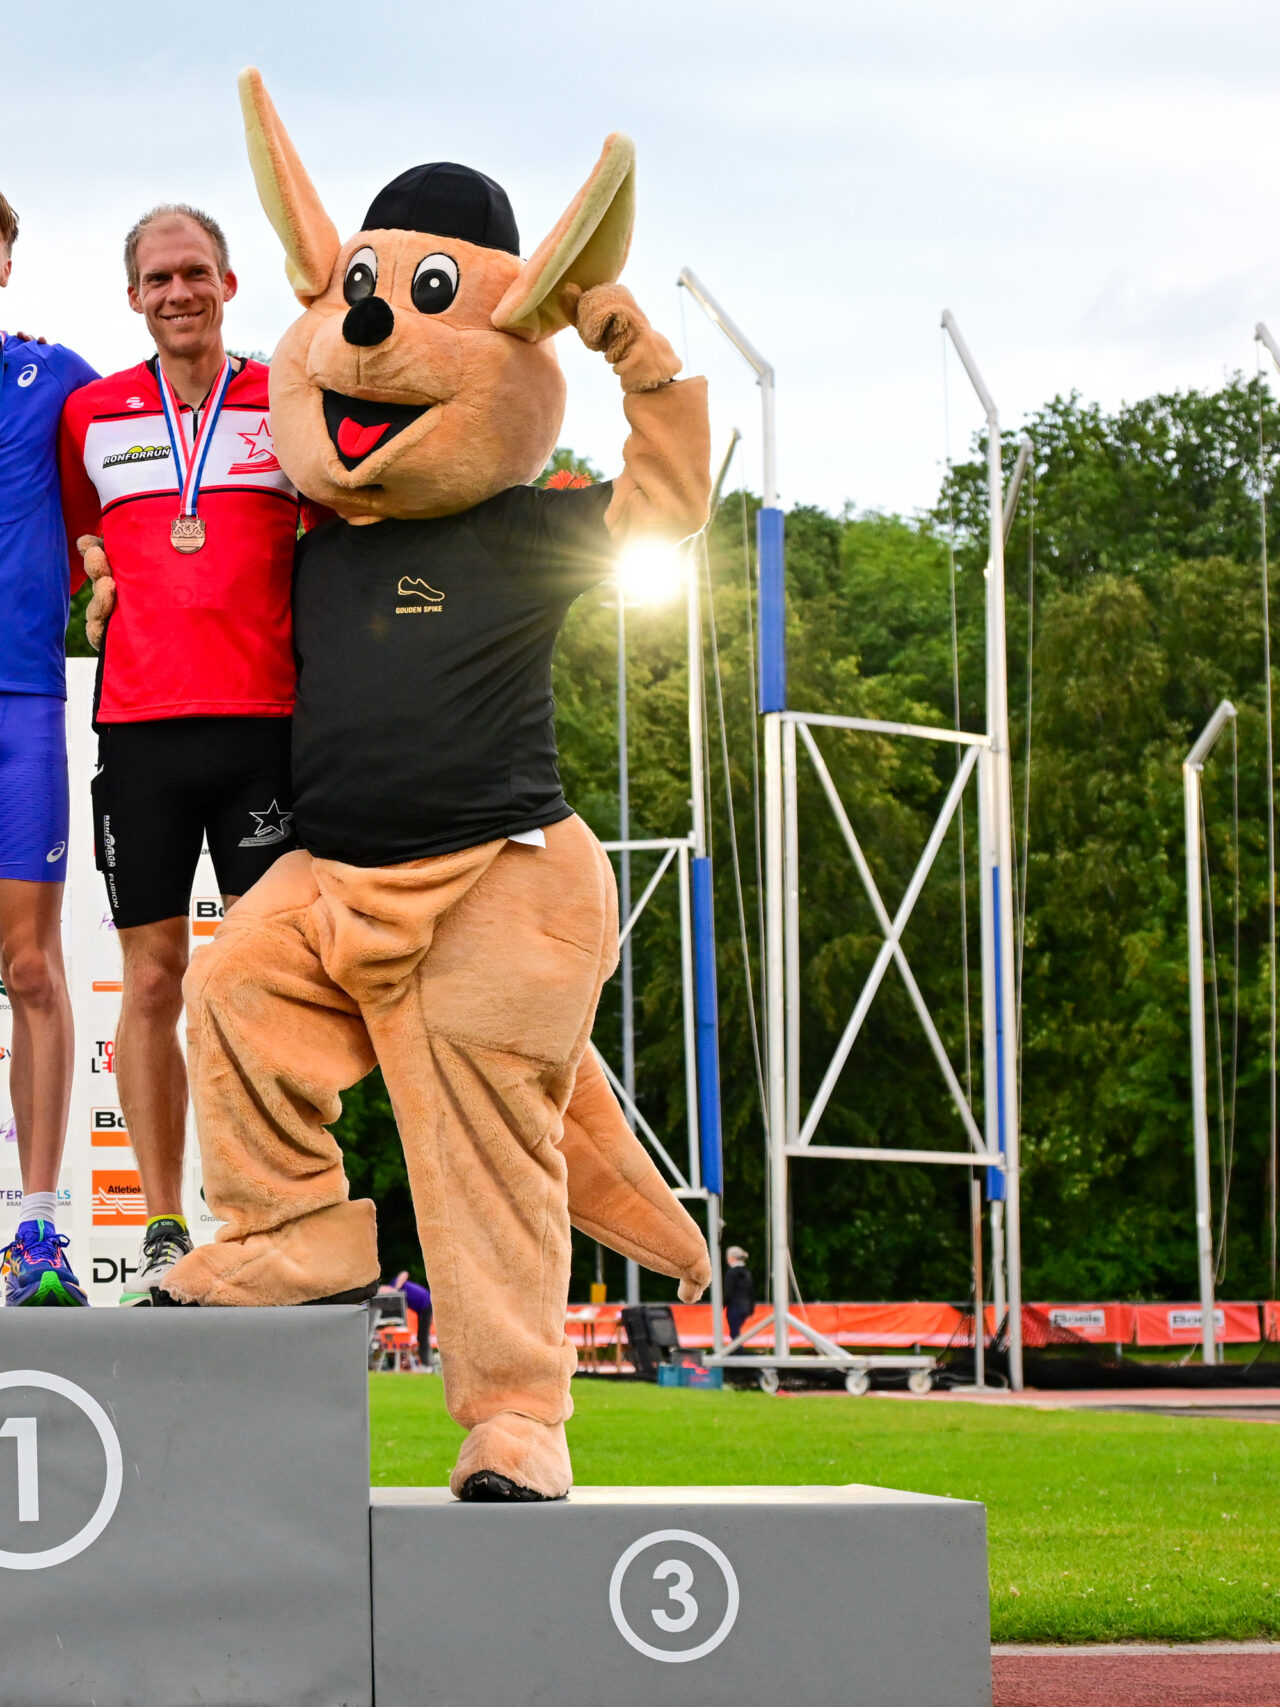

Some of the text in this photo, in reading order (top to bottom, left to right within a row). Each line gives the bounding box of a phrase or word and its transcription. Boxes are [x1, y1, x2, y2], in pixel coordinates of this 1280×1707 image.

[104, 448, 170, 465] RONFORRUN
[396, 605, 443, 614] GOUDEN SPIKE
[108, 873, 120, 908] FUSION
[650, 1559, 698, 1632] 3
